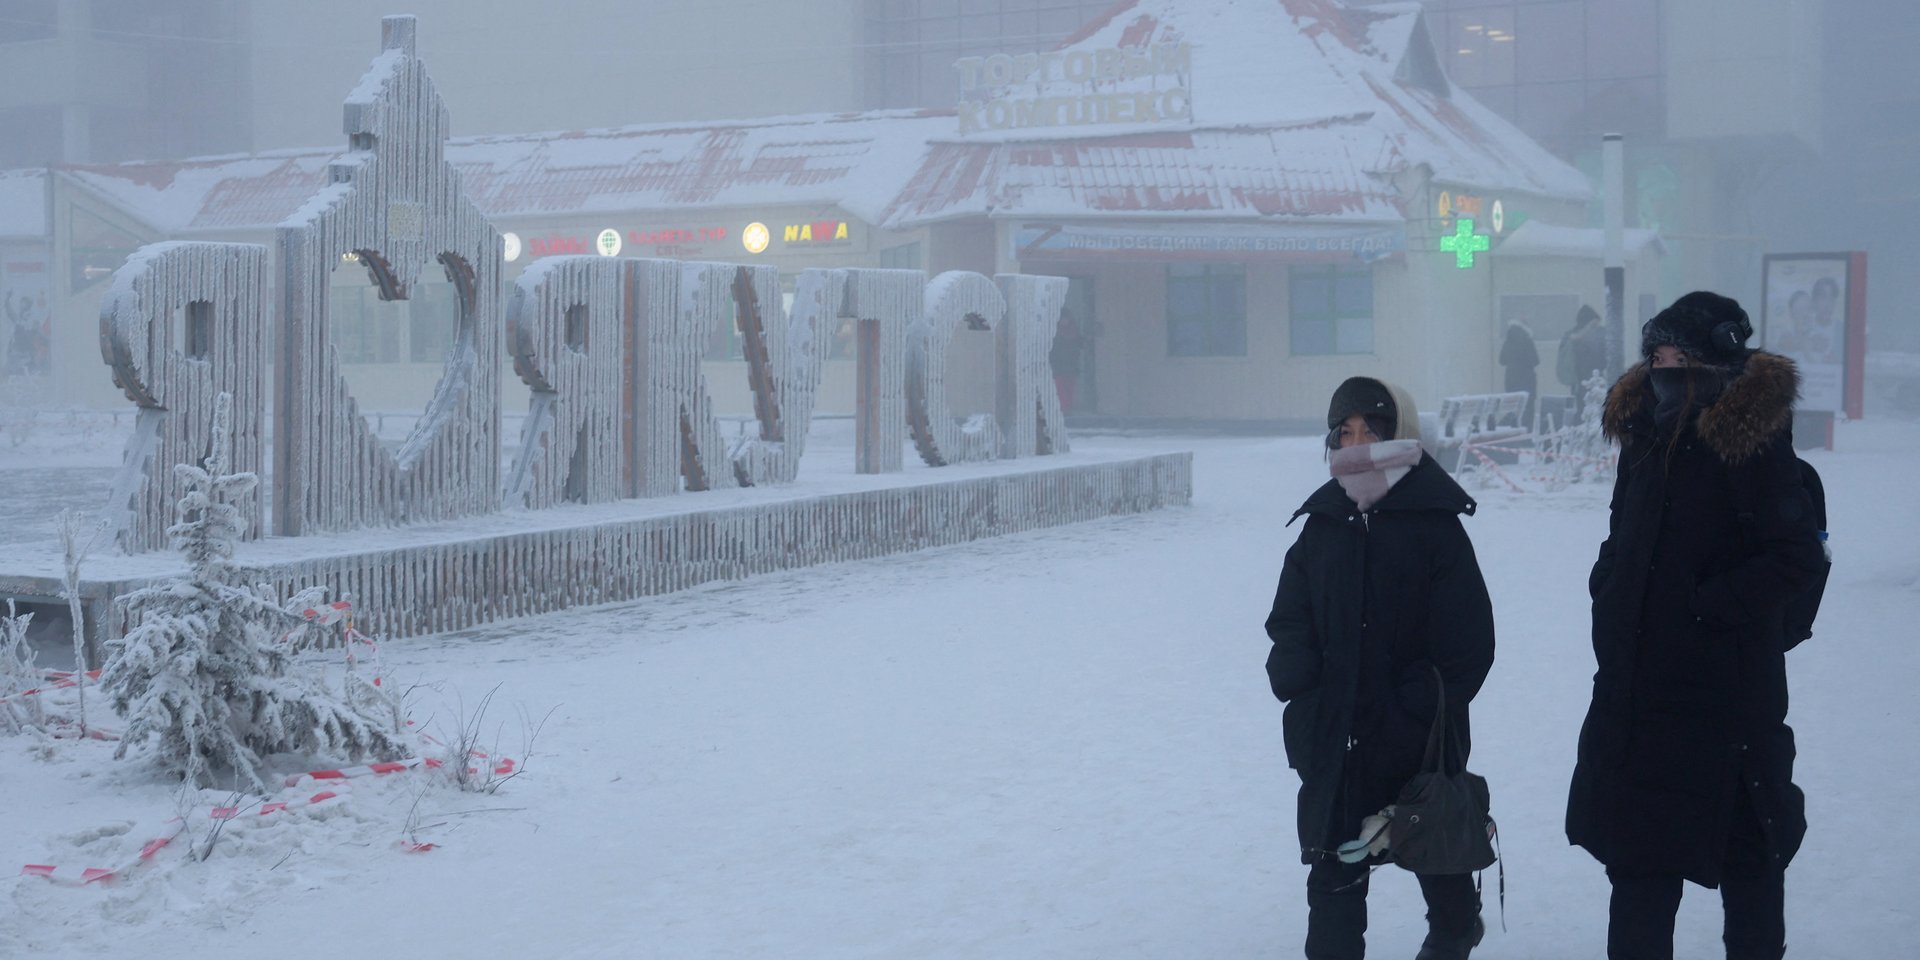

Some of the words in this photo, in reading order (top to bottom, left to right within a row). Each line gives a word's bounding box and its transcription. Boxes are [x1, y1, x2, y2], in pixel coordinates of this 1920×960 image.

[955, 42, 1192, 91] ТОРГОВЫЙ
[959, 89, 1187, 135] КОМПЛЕКС
[1215, 237, 1249, 250] ТАК
[1255, 238, 1309, 250] БЫЛО
[1317, 237, 1392, 252] ВСЕГДА!
